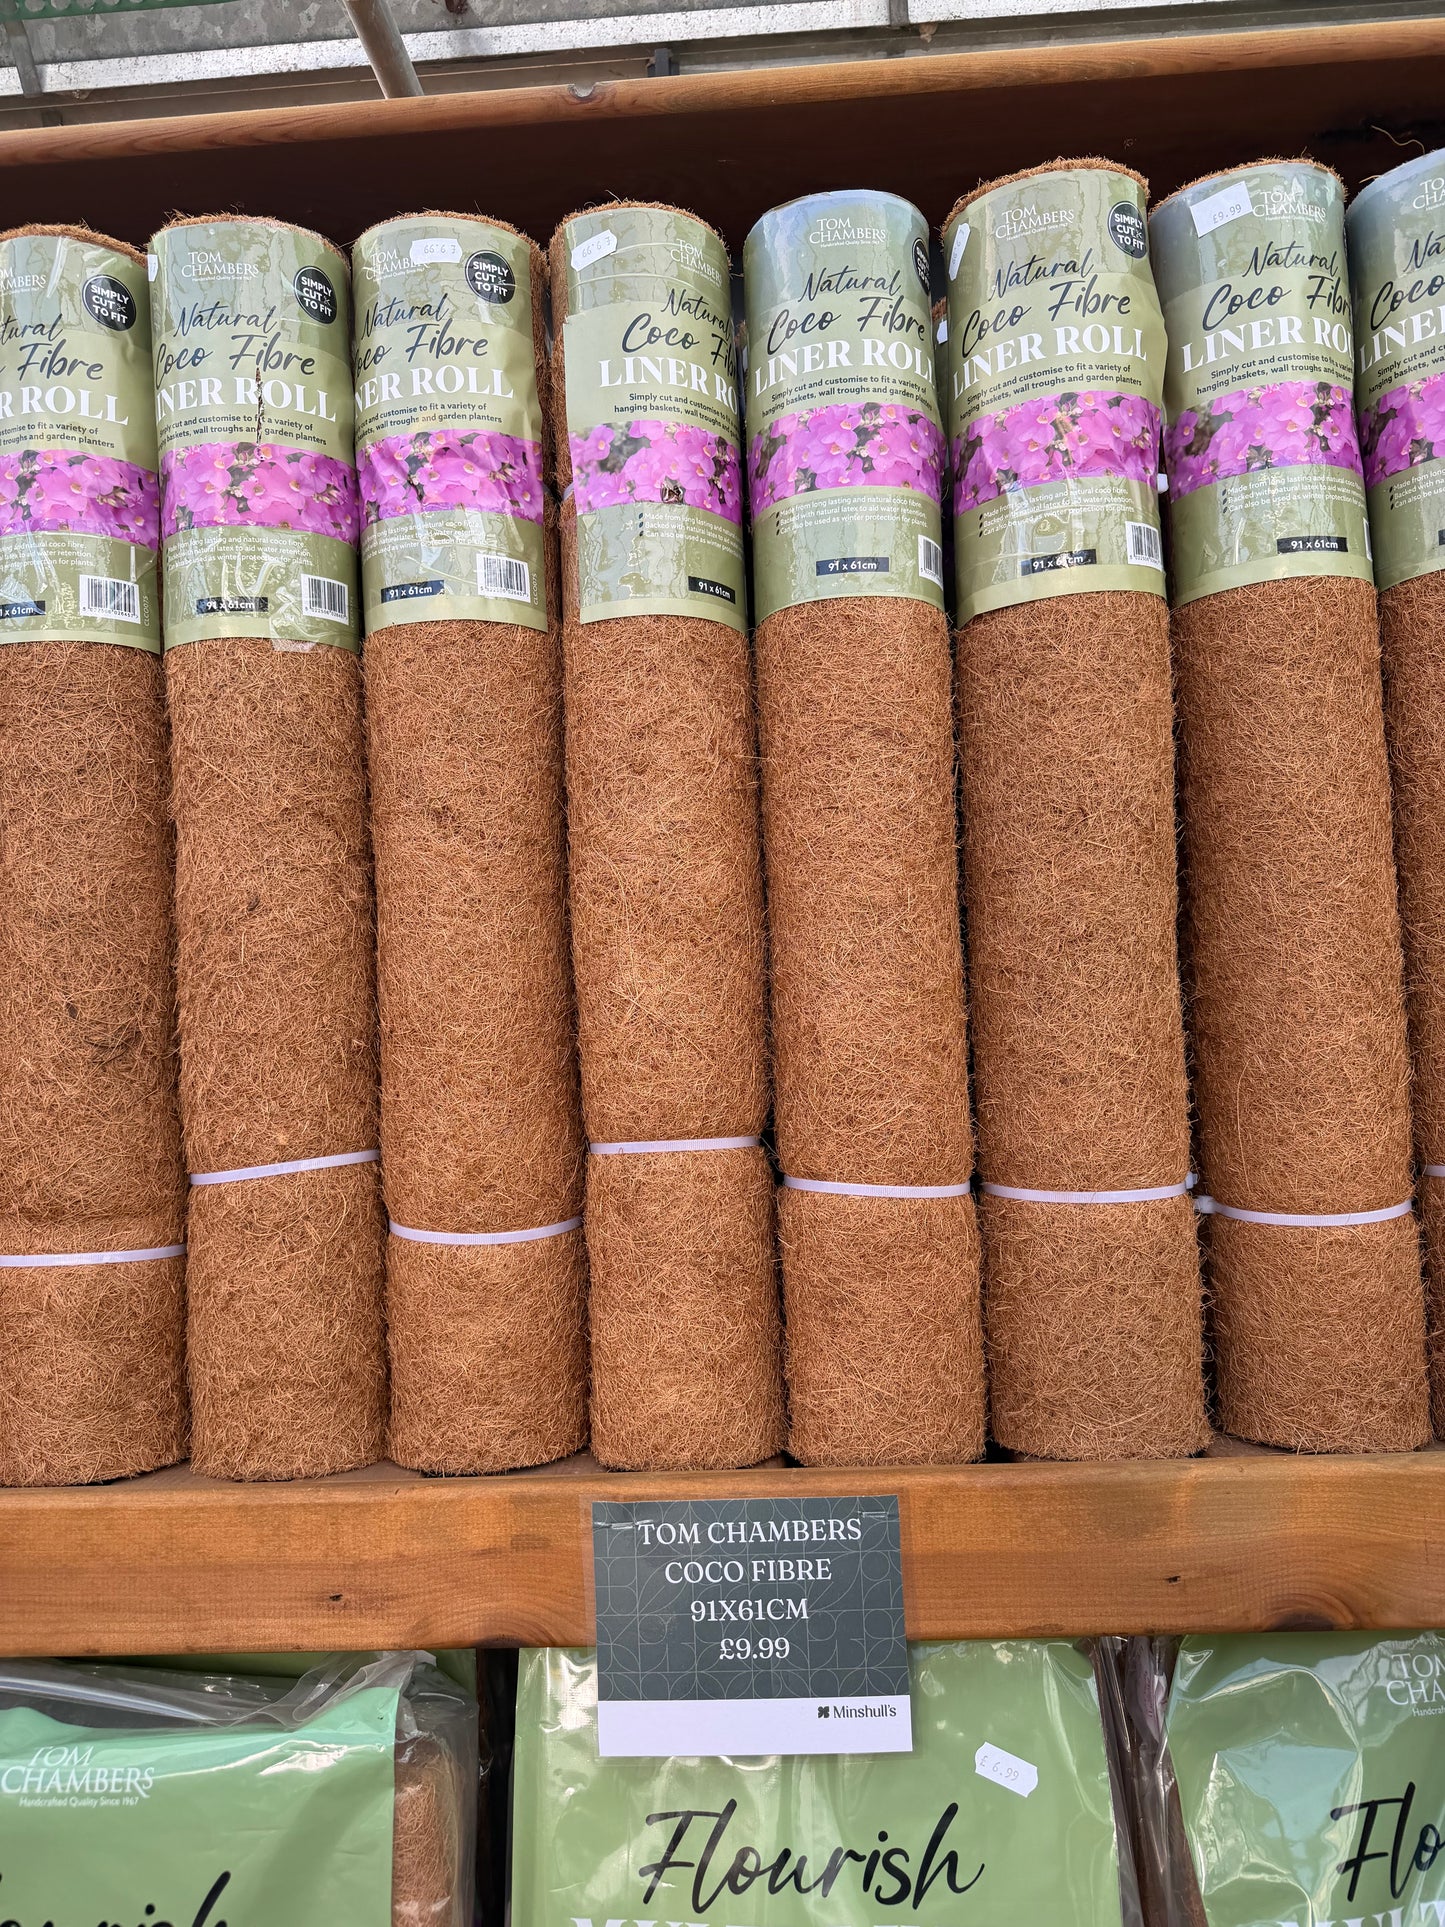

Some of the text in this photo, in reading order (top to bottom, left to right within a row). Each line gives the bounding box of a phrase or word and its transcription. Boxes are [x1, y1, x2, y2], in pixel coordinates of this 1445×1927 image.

[1260, 191, 1297, 204] TOM
[1002, 204, 1037, 224] TOM
[1114, 213, 1143, 230] SIMPLY
[1213, 204, 1242, 224] £9.99
[1253, 204, 1326, 223] CHAMBERS
[816, 217, 852, 232] TOM
[995, 209, 1075, 240] CHAMBERS
[1116, 224, 1135, 236] CUT
[809, 226, 887, 244] CHAMBERS
[1118, 234, 1145, 251] TO FIT
[188, 252, 222, 264] TOM
[370, 249, 398, 265] TOM
[676, 238, 703, 261] TOM
[1242, 241, 1338, 277] Natural
[181, 263, 259, 278] CHAMBERS
[473, 261, 509, 277] SIMPLY
[475, 271, 497, 283] CUT
[988, 248, 1094, 301] Natural
[301, 276, 332, 297] SIMPLY
[476, 282, 508, 297] TO FIT
[798, 265, 902, 302] Natural
[91, 284, 129, 304] SIMPLY
[92, 295, 115, 310] CUT
[303, 287, 322, 301] CUT
[1371, 275, 1445, 331] Coco
[93, 305, 128, 325] TO FIT
[303, 297, 332, 317] TO FIT
[361, 293, 450, 341] Natural
[962, 274, 1131, 358] Coco Fibre
[1202, 283, 1292, 331] Coco
[173, 301, 277, 337] Natural
[767, 295, 925, 355] Coco Fibre
[406, 318, 489, 363] Fibre
[622, 313, 700, 353] Coco
[1181, 316, 1306, 374] LINER
[17, 339, 104, 381] Fibre
[156, 332, 315, 390] Coco Fibre
[755, 340, 853, 398] LINER
[953, 323, 1147, 400] LINER ROLL
[1211, 353, 1320, 379] Simply cut and customise
[1378, 346, 1436, 377] Simply cut and
[598, 356, 709, 396] LINER
[1196, 364, 1322, 396] hanging baskets, wall troughs
[1394, 362, 1429, 379] baskets,
[410, 364, 514, 399] ROLL
[771, 376, 921, 402] Simply and customise variety
[967, 363, 1121, 405] Simply and customise variety
[981, 374, 1142, 408] baskets, wall troughs and garden planters
[21, 385, 128, 426] ROLL
[234, 377, 336, 422] ROLL
[629, 393, 673, 402] Simply cut
[786, 385, 915, 406] baskets, wall troughs and garden
[380, 402, 475, 420] customise to variety
[614, 404, 683, 415] hanging baskets,
[56, 423, 86, 434] variety
[199, 414, 313, 431] customise to variety of
[389, 413, 502, 427] troughs garden planters
[47, 433, 114, 448] garden planters
[211, 425, 327, 445] troughs garden planters
[812, 500, 827, 508] long
[828, 497, 851, 505] lasting
[816, 506, 840, 516] natural
[841, 504, 858, 512] latex
[814, 517, 831, 525] used
[865, 514, 901, 522] protection
[1291, 540, 1303, 549] 91
[1314, 540, 1339, 549] 61cm
[828, 562, 839, 572] 91
[850, 560, 877, 570] 61cm
[1033, 559, 1045, 570] 91
[389, 586, 433, 598] 91 x 61cm
[698, 581, 730, 600] 91 x 61cm
[12, 607, 33, 615] 61cm
[637, 1518, 862, 1545] TOM CHAMBERS
[665, 1558, 832, 1584] COCO FIBRE
[690, 1598, 809, 1622] 91X61CM
[719, 1637, 790, 1660] £9.99
[28, 1746, 94, 1767] TOM
[980, 1755, 1019, 1781] £ 6.99
[1, 1766, 154, 1798] CHAMBERS
[19, 1797, 139, 1808] Handcrafted Quality Since 1967
[638, 1798, 985, 1915] Flourish
